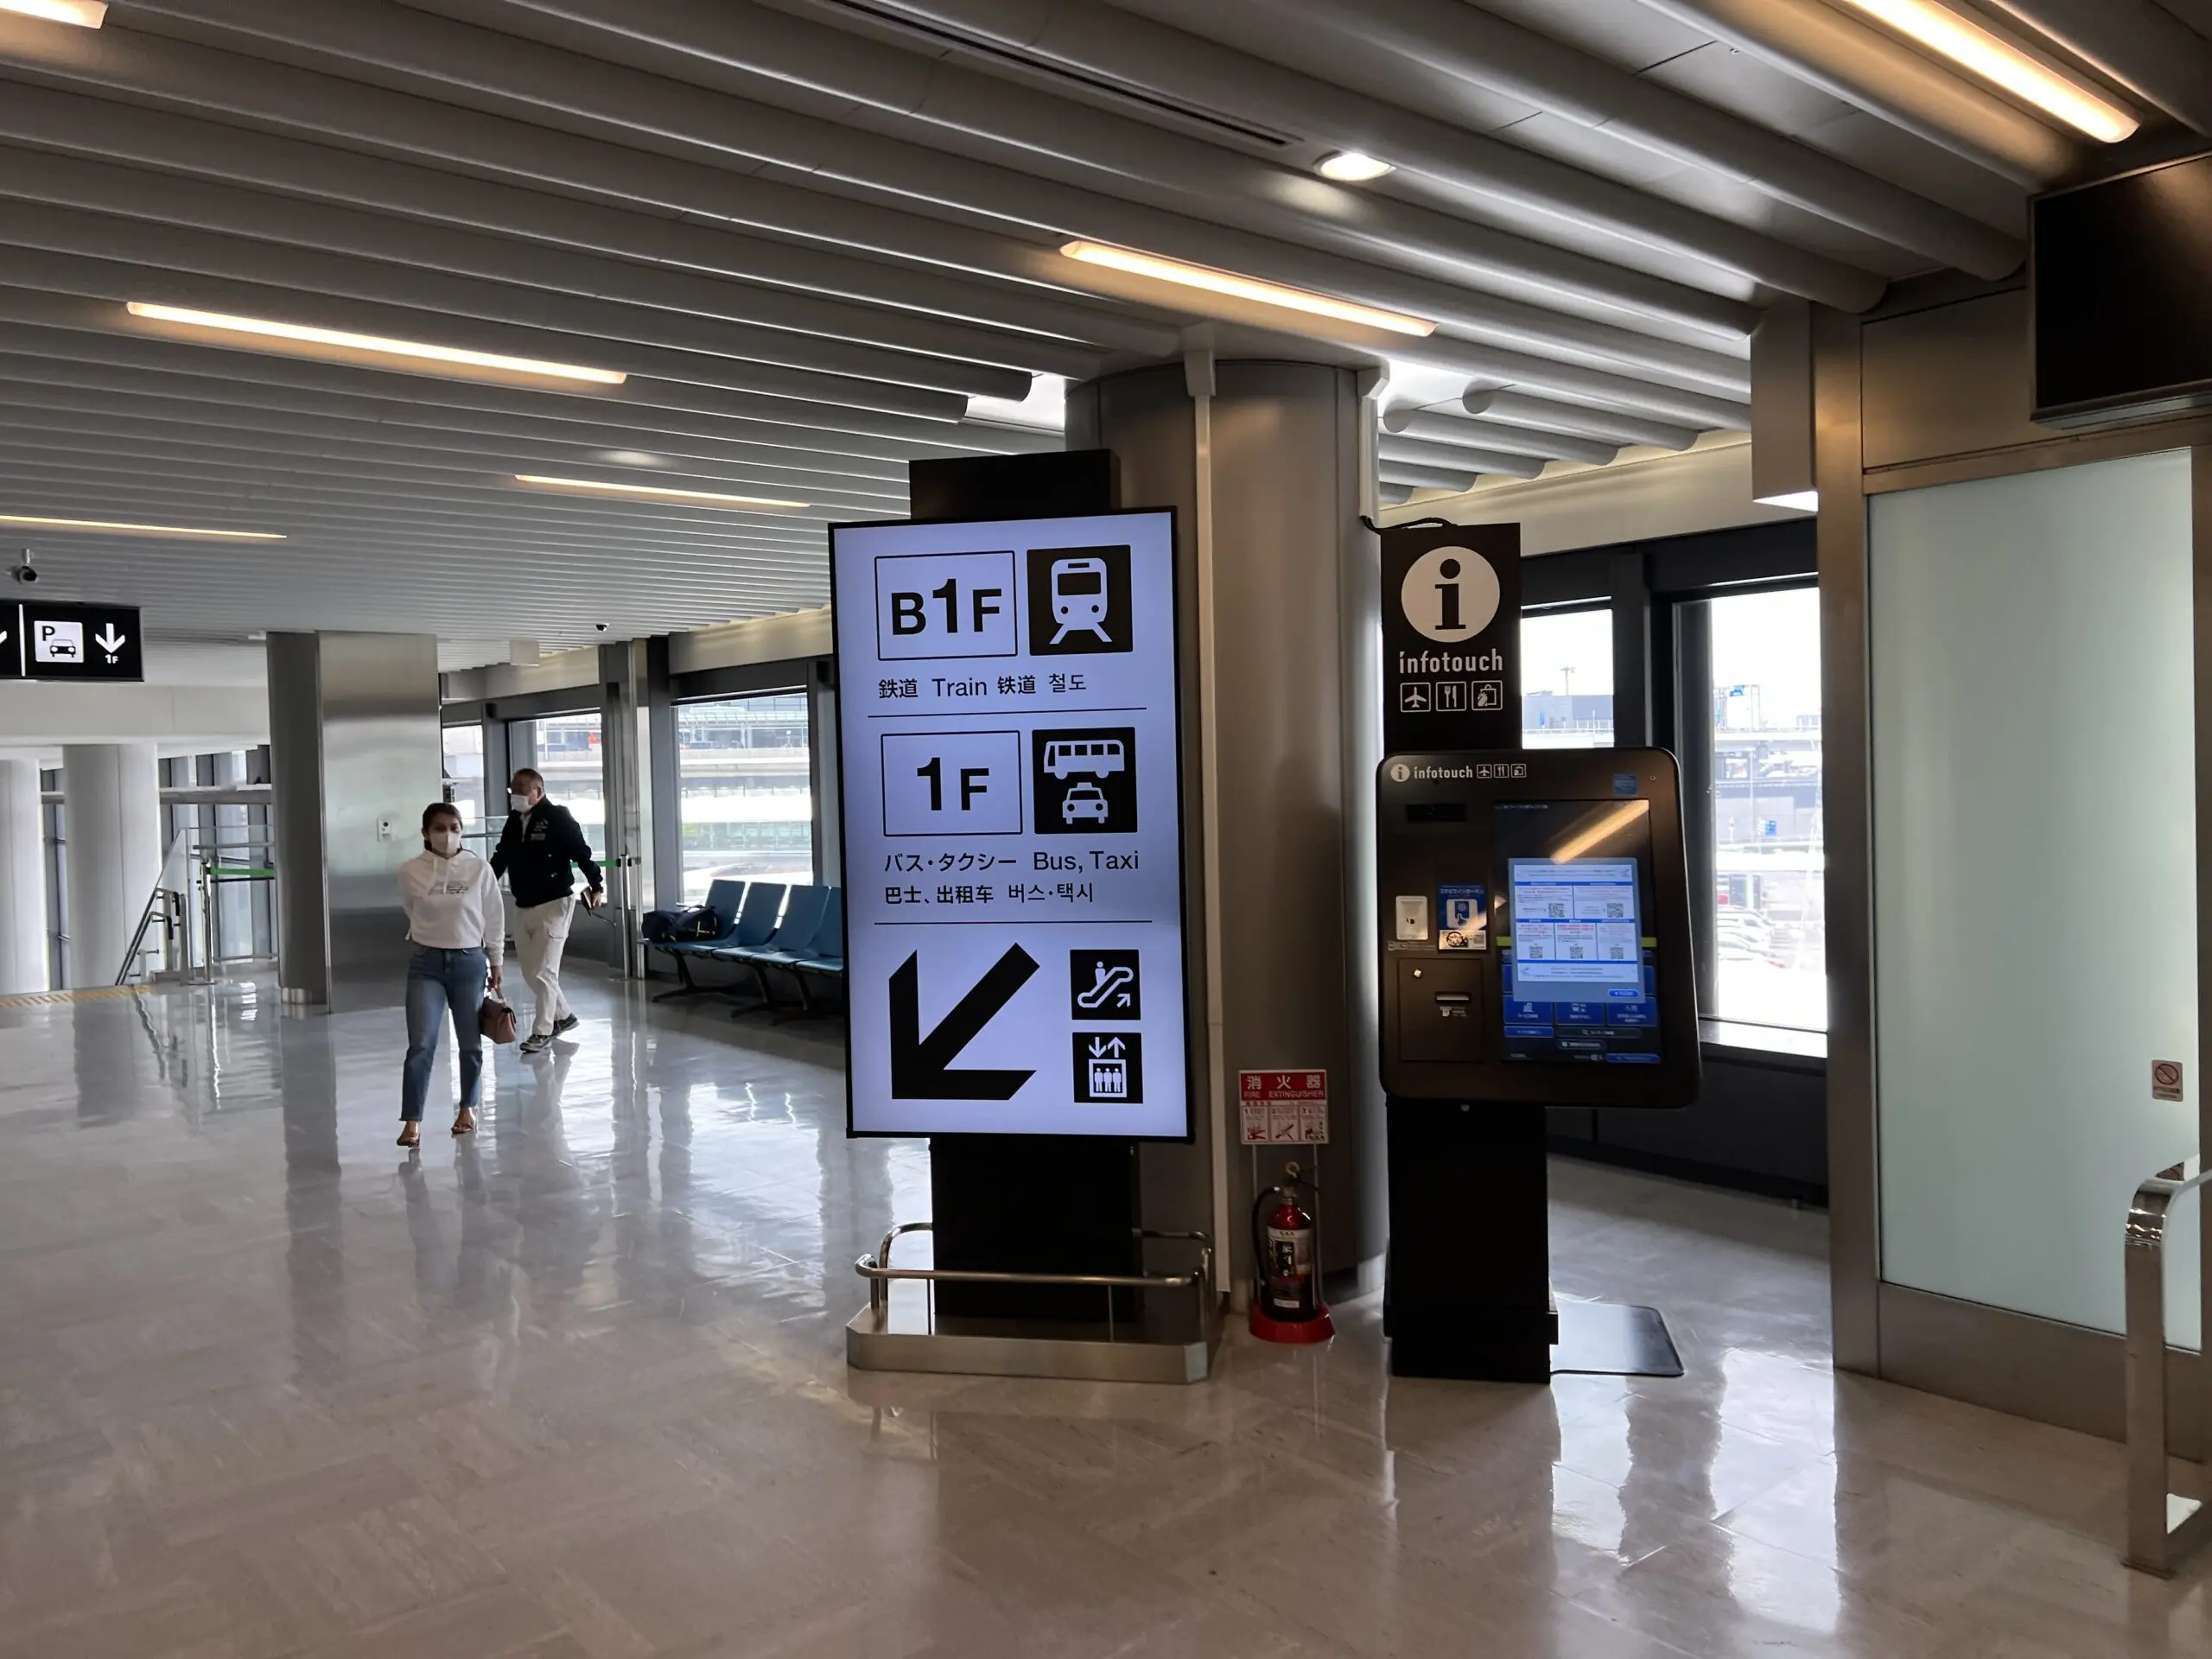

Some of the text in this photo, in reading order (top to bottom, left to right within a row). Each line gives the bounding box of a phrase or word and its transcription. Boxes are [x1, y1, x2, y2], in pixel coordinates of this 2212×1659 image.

[891, 578, 1002, 636] B1F
[41, 625, 56, 642] P
[105, 654, 119, 664] 1F
[1399, 647, 1503, 674] infotouch
[878, 672, 1087, 699] 鉄道 Train 铁道 철도
[1414, 765, 1473, 779] infotouch
[916, 757, 990, 811] 1F
[884, 849, 1140, 874] バス・タクシー Bus, Taxi
[884, 884, 995, 905] 巴士、出租车
[1243, 1090, 1325, 1099] FIRE EXTINGUISHER
